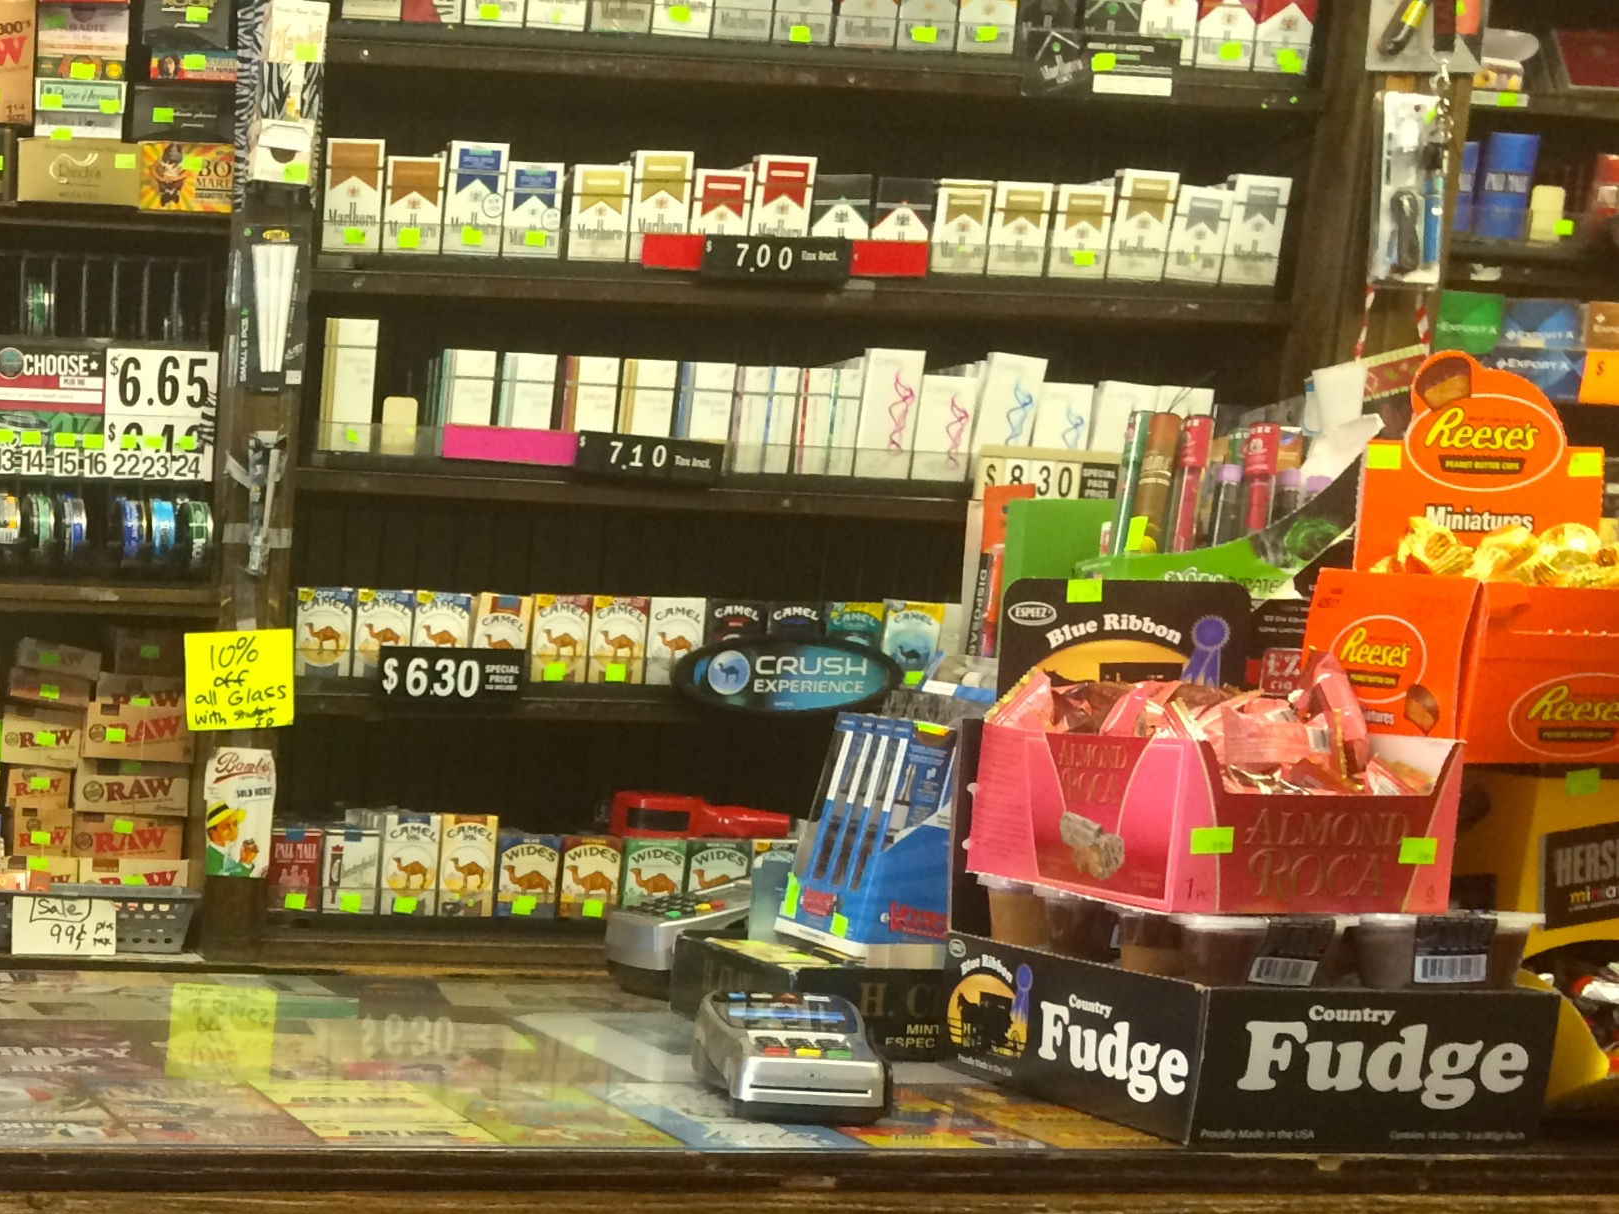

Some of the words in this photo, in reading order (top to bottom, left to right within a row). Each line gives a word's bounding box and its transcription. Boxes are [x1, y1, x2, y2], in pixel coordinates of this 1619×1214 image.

[736, 244, 792, 270] 7.00
[23, 354, 89, 375] CHOOSE
[110, 356, 208, 406] $6.65
[1425, 408, 1539, 450] Reese's
[22, 449, 44, 472] 14
[85, 452, 106, 475] 16
[113, 455, 139, 476] 22
[609, 441, 666, 470] 7.10
[174, 455, 200, 478] 24
[1426, 506, 1533, 531] Miniatures
[301, 598, 349, 615] CAMEL
[539, 602, 587, 622] CAMEL
[597, 604, 644, 623] CAMEL
[654, 607, 701, 623] CAMEL
[714, 605, 760, 621] CAMEL
[773, 606, 819, 622] CAMEL
[1015, 607, 1048, 618] ESPEEZ
[482, 615, 524, 632] CAMEL
[1046, 620, 1098, 649] Blue
[1103, 613, 1182, 646] Ribbon
[210, 636, 259, 670] 10%
[1340, 627, 1411, 667] Reese's
[485, 665, 519, 674] SPECIAL
[755, 655, 867, 676] CRUSH
[214, 670, 249, 687] off
[489, 675, 514, 684] PRICE
[754, 678, 864, 694] EXPERIENCE
[195, 690, 217, 706] all
[228, 685, 286, 706] Glass
[195, 711, 226, 725] with
[1057, 741, 1127, 768] ALMOND
[105, 778, 173, 801] RAW
[389, 825, 435, 845] CAMEL
[446, 824, 493, 845] CAMEL
[1244, 808, 1410, 846] ALMOND
[94, 828, 167, 852] RAW
[275, 845, 294, 859] PALL
[297, 845, 318, 859] MALL
[503, 847, 556, 866] WIDES
[566, 847, 619, 866] WIDES
[631, 849, 682, 866] WIDES
[692, 852, 744, 869] WIDES
[38, 900, 82, 917] Sale
[1069, 994, 1112, 1019] Country
[1309, 1005, 1394, 1025] Country
[1038, 1000, 1189, 1102] Fudge
[1237, 1021, 1529, 1110] Fudge
[1200, 1129, 1239, 1141] Proudly
[1243, 1129, 1268, 1140] Made
[1280, 1129, 1293, 1140] the
[1296, 1129, 1315, 1140] USA
